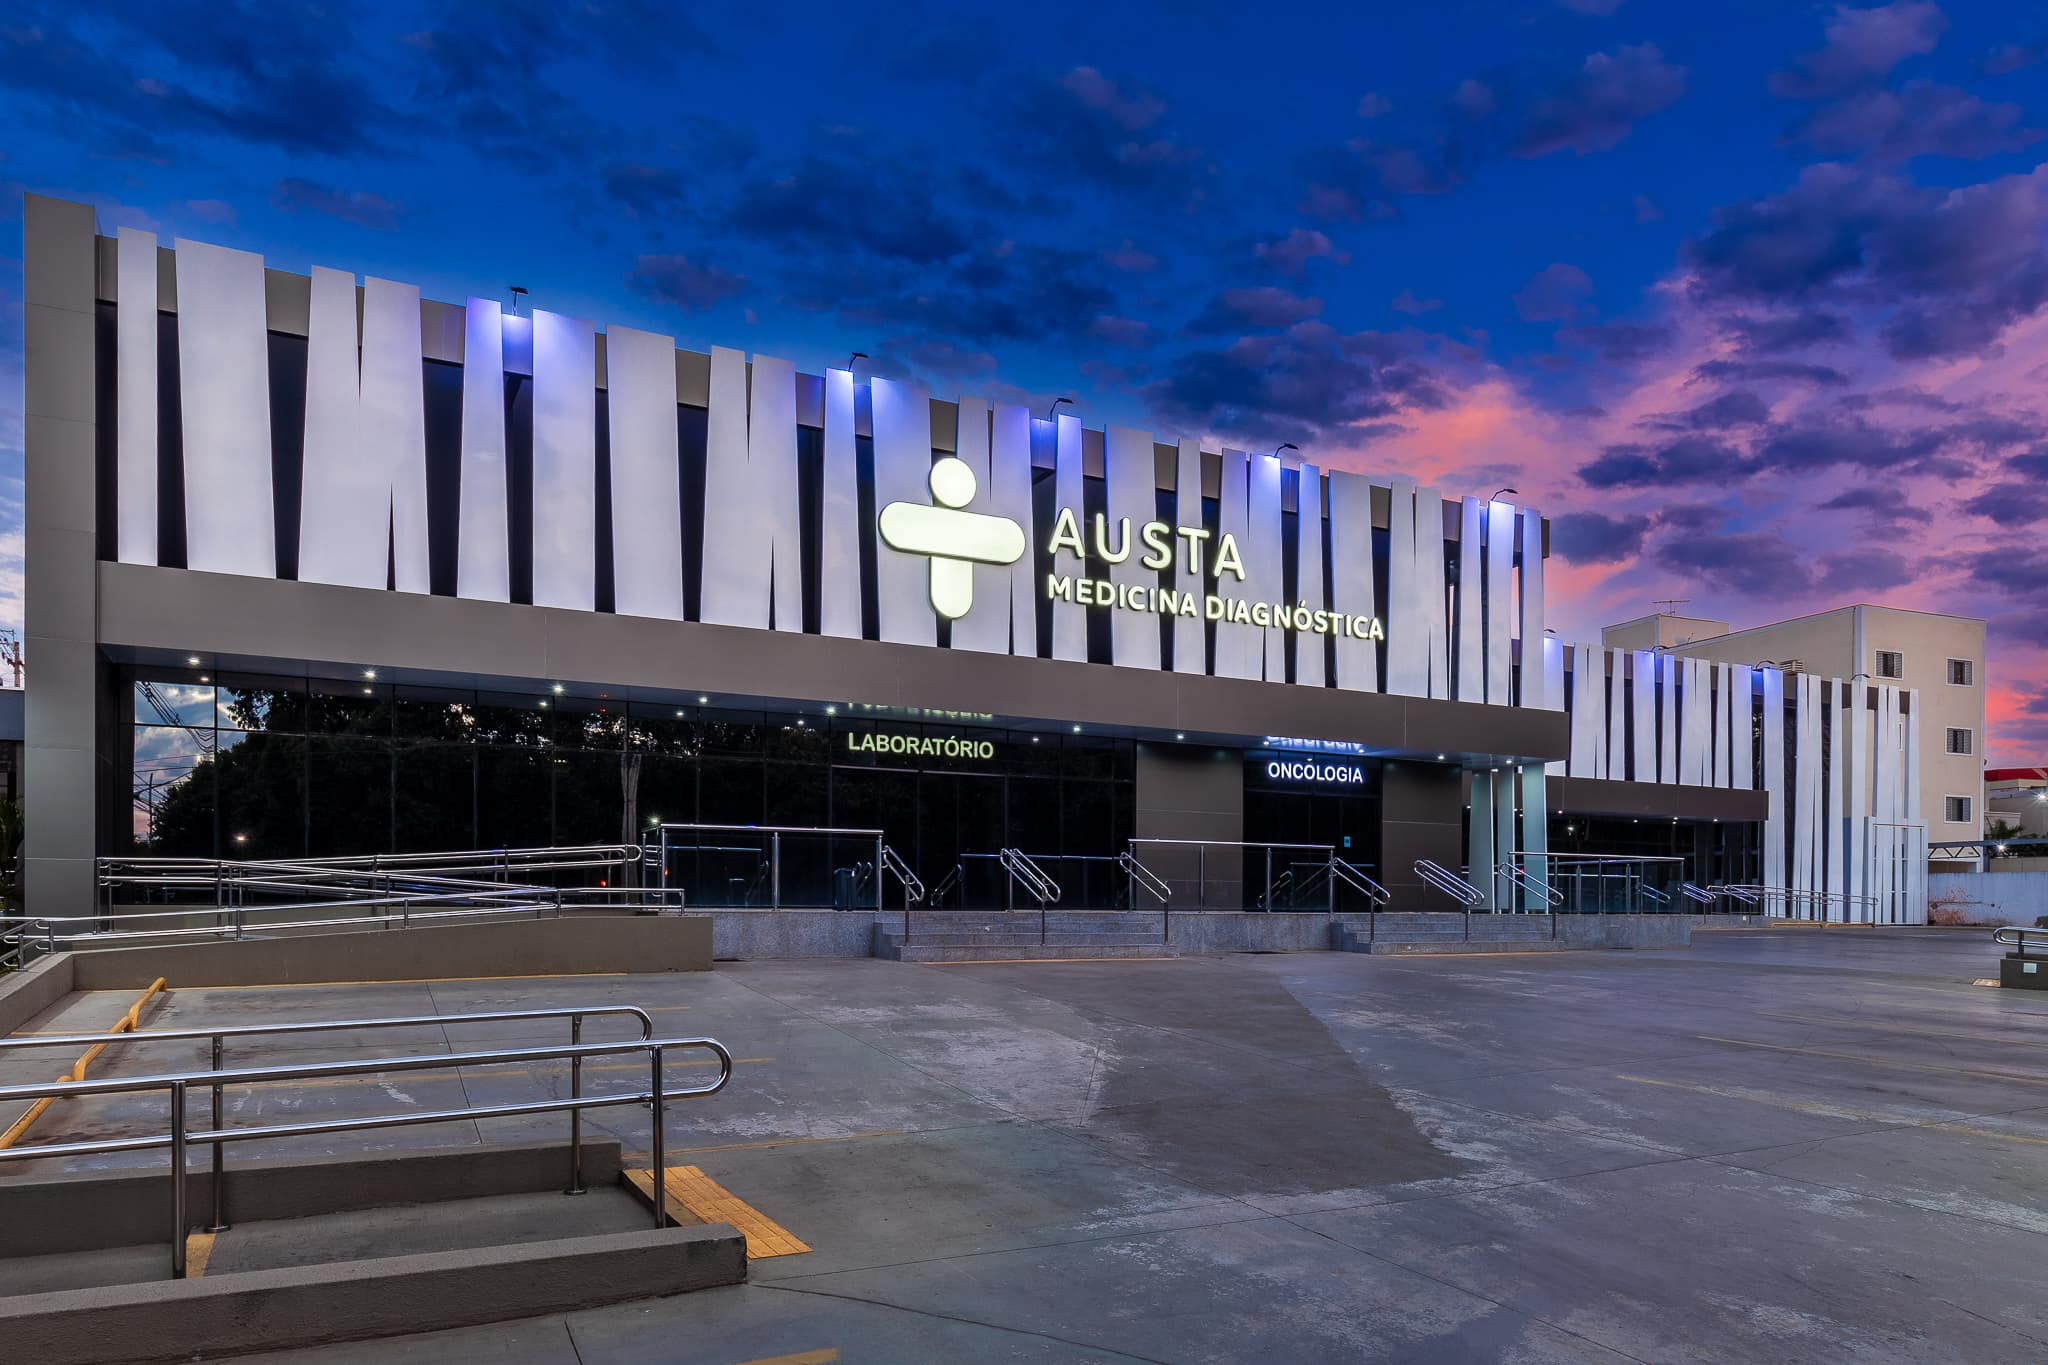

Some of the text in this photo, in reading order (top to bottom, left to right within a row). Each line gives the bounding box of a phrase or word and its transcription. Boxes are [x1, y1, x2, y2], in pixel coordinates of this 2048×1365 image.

[1048, 507, 1246, 581] AUSTA
[1047, 574, 1385, 641] MEDICINA DIAGNÓSTICA
[848, 732, 994, 759] LABORATÓRIO
[1268, 762, 1364, 784] ONCOLOGIA
